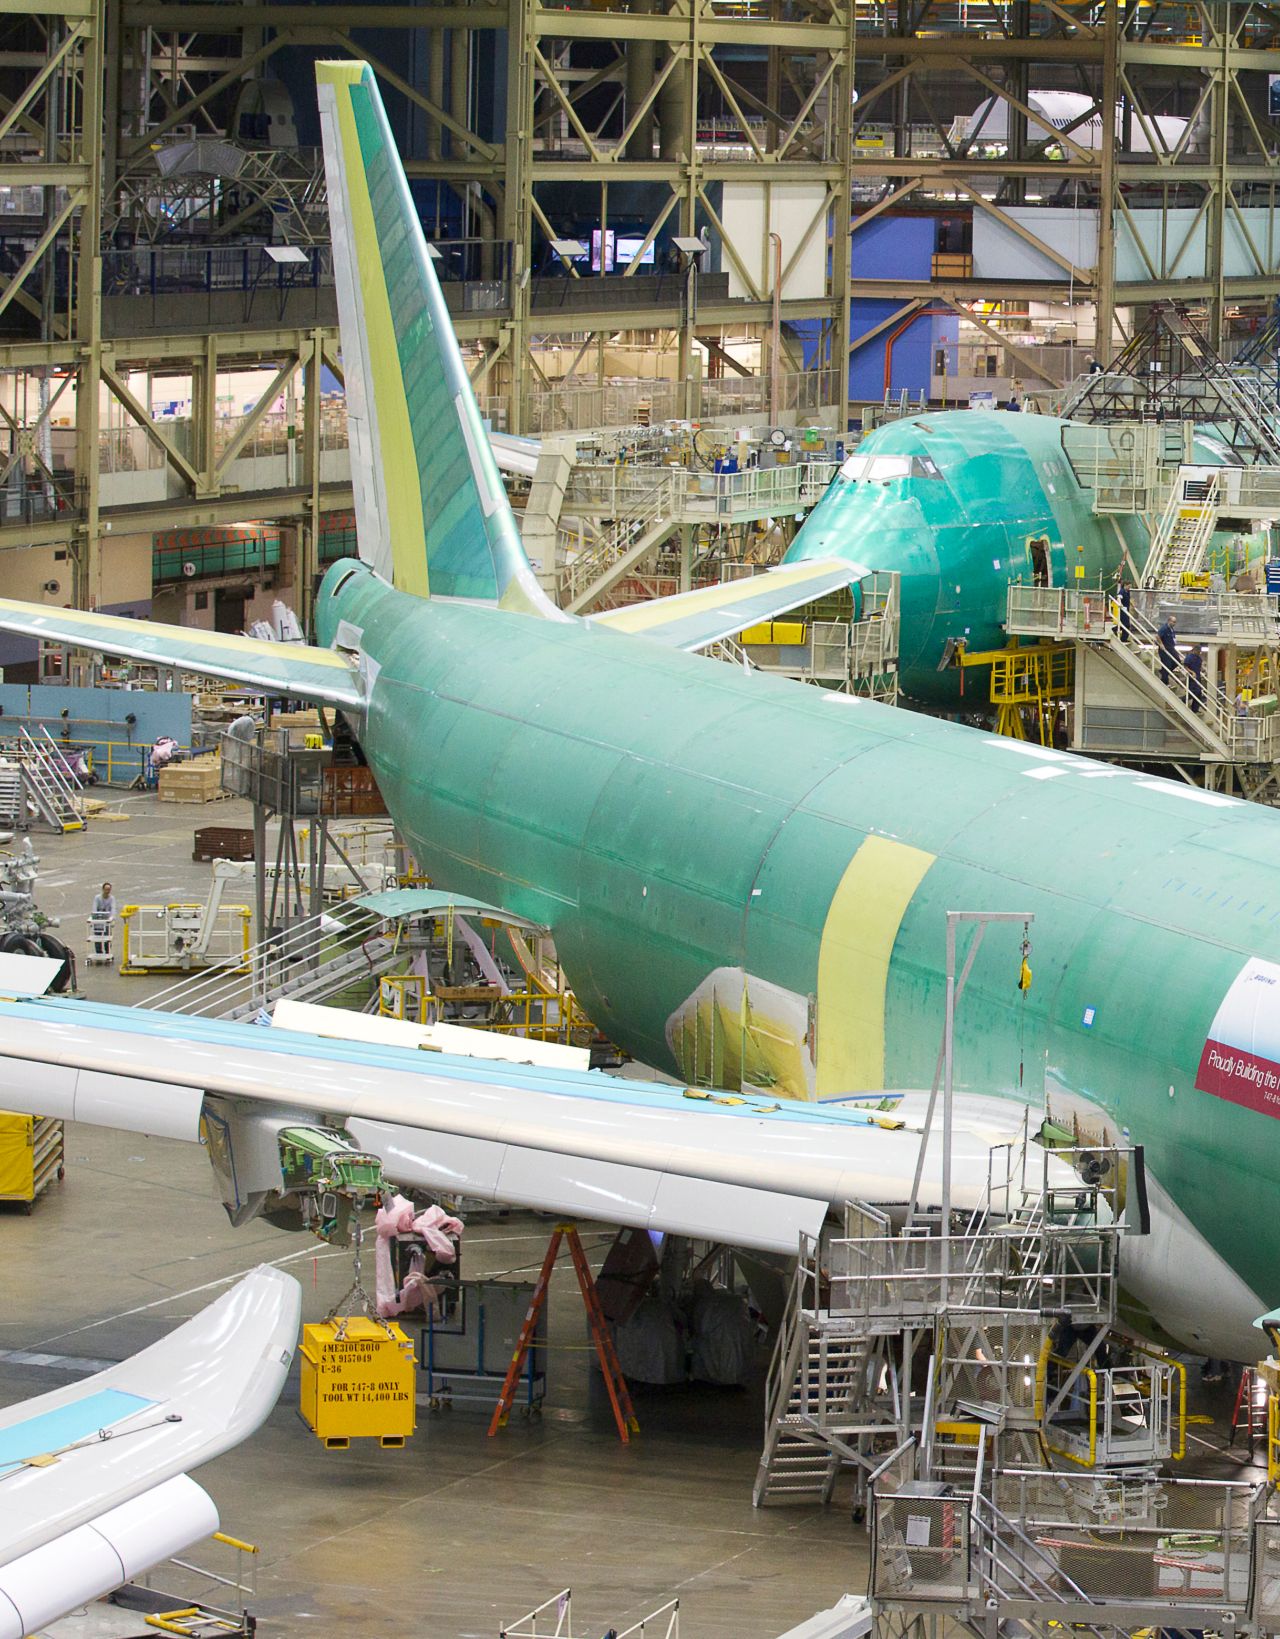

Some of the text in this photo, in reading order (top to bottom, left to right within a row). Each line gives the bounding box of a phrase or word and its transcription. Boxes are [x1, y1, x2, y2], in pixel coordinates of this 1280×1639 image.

[1207, 1049, 1237, 1077] Proudly
[1235, 1059, 1265, 1088] Building
[1264, 1070, 1277, 1089] the
[332, 1382, 400, 1392] FOR 747-8 ONLY
[323, 1392, 409, 1403] TOOL WT 14,400 LBS
